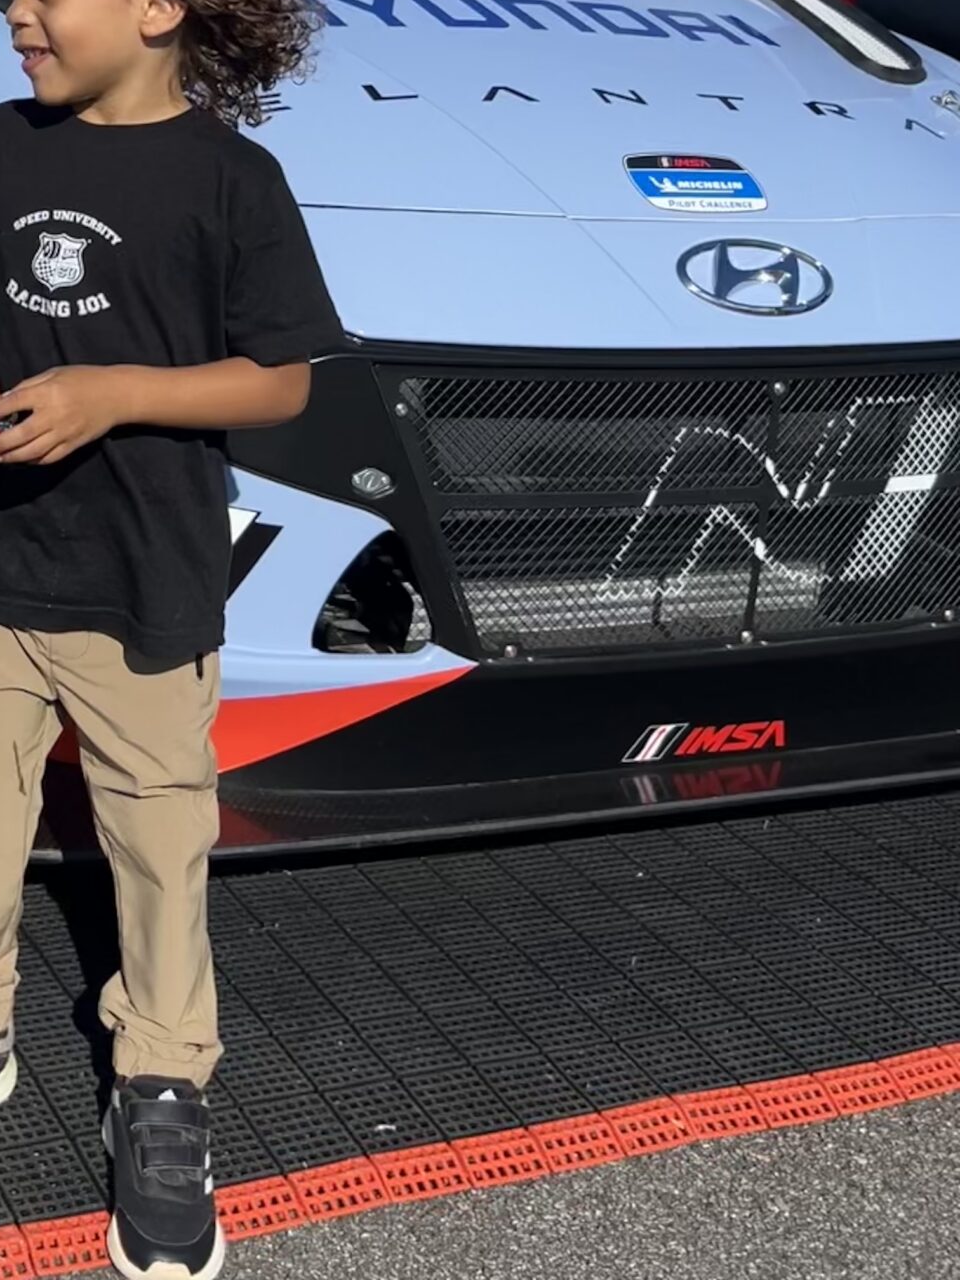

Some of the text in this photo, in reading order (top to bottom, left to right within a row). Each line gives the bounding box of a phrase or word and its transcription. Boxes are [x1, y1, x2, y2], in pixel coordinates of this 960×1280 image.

[677, 180, 743, 190] MICHELIN
[668, 199, 753, 209] PILOT CHALLENGE
[13, 209, 123, 246] SPEED UNIVERSITY
[5, 278, 111, 318] RACING 101
[673, 719, 785, 756] IMSA
